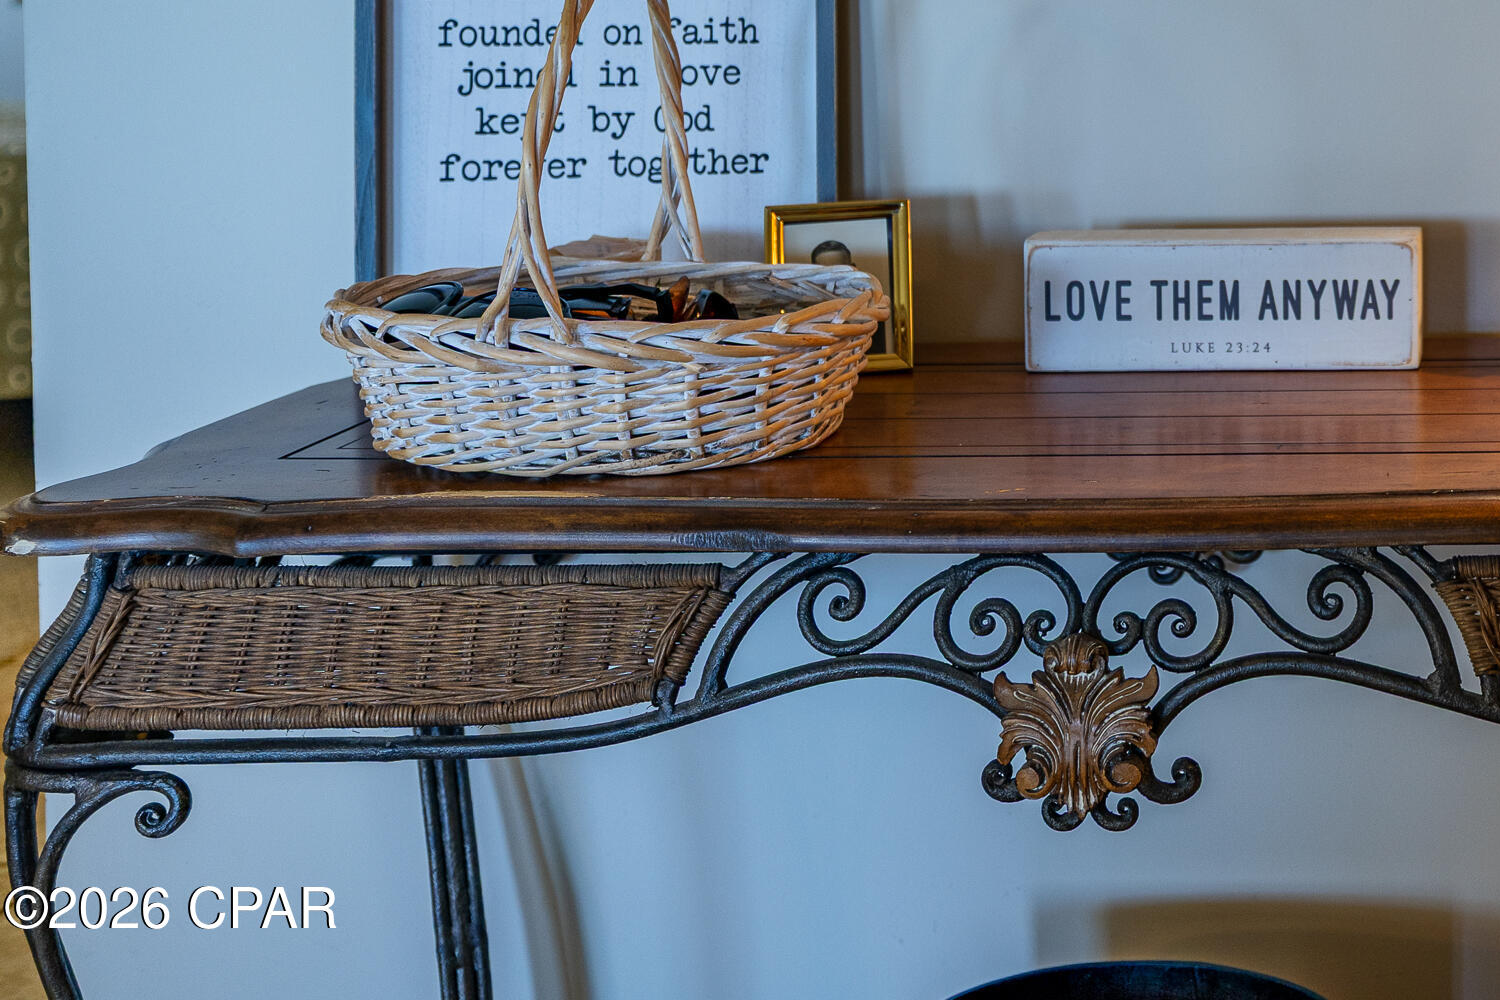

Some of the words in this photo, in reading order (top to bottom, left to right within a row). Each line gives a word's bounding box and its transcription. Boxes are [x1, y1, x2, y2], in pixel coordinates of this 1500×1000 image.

[438, 19, 580, 48] founde
[603, 24, 643, 46] on
[457, 60, 578, 97] join
[598, 60, 639, 88] in
[681, 63, 741, 86] ove
[475, 107, 565, 141] ket
[588, 105, 635, 140] by
[438, 153, 588, 183] foreer
[608, 147, 770, 184] togther
[1044, 280, 1133, 322] LOVE
[1150, 280, 1240, 321] THEM
[1258, 279, 1401, 321] ANYWAY
[1171, 342, 1216, 354] LUKE
[1226, 341, 1273, 354] 23:24
